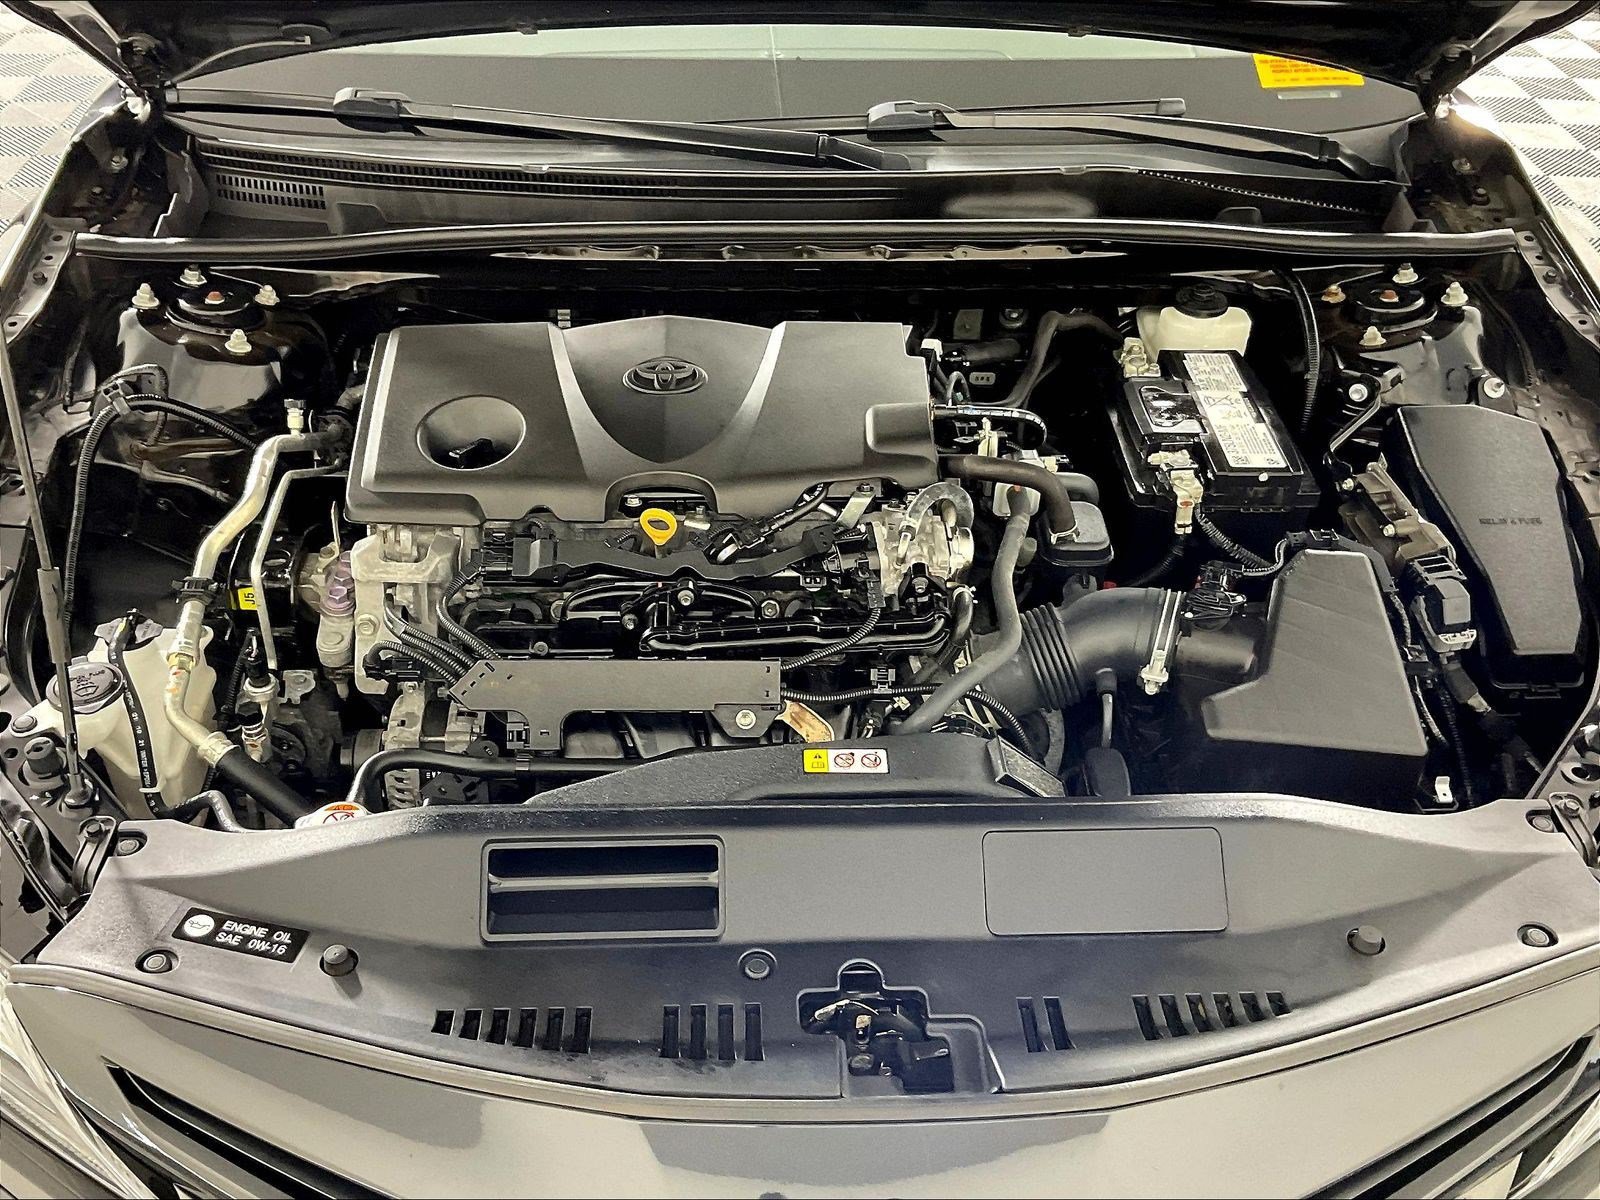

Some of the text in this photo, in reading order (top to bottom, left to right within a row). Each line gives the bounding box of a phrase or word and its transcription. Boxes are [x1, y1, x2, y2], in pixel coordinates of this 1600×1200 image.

[244, 593, 255, 604] J5
[223, 920, 292, 943] ENGINE OIL
[215, 932, 287, 954] SAE 0W-16
